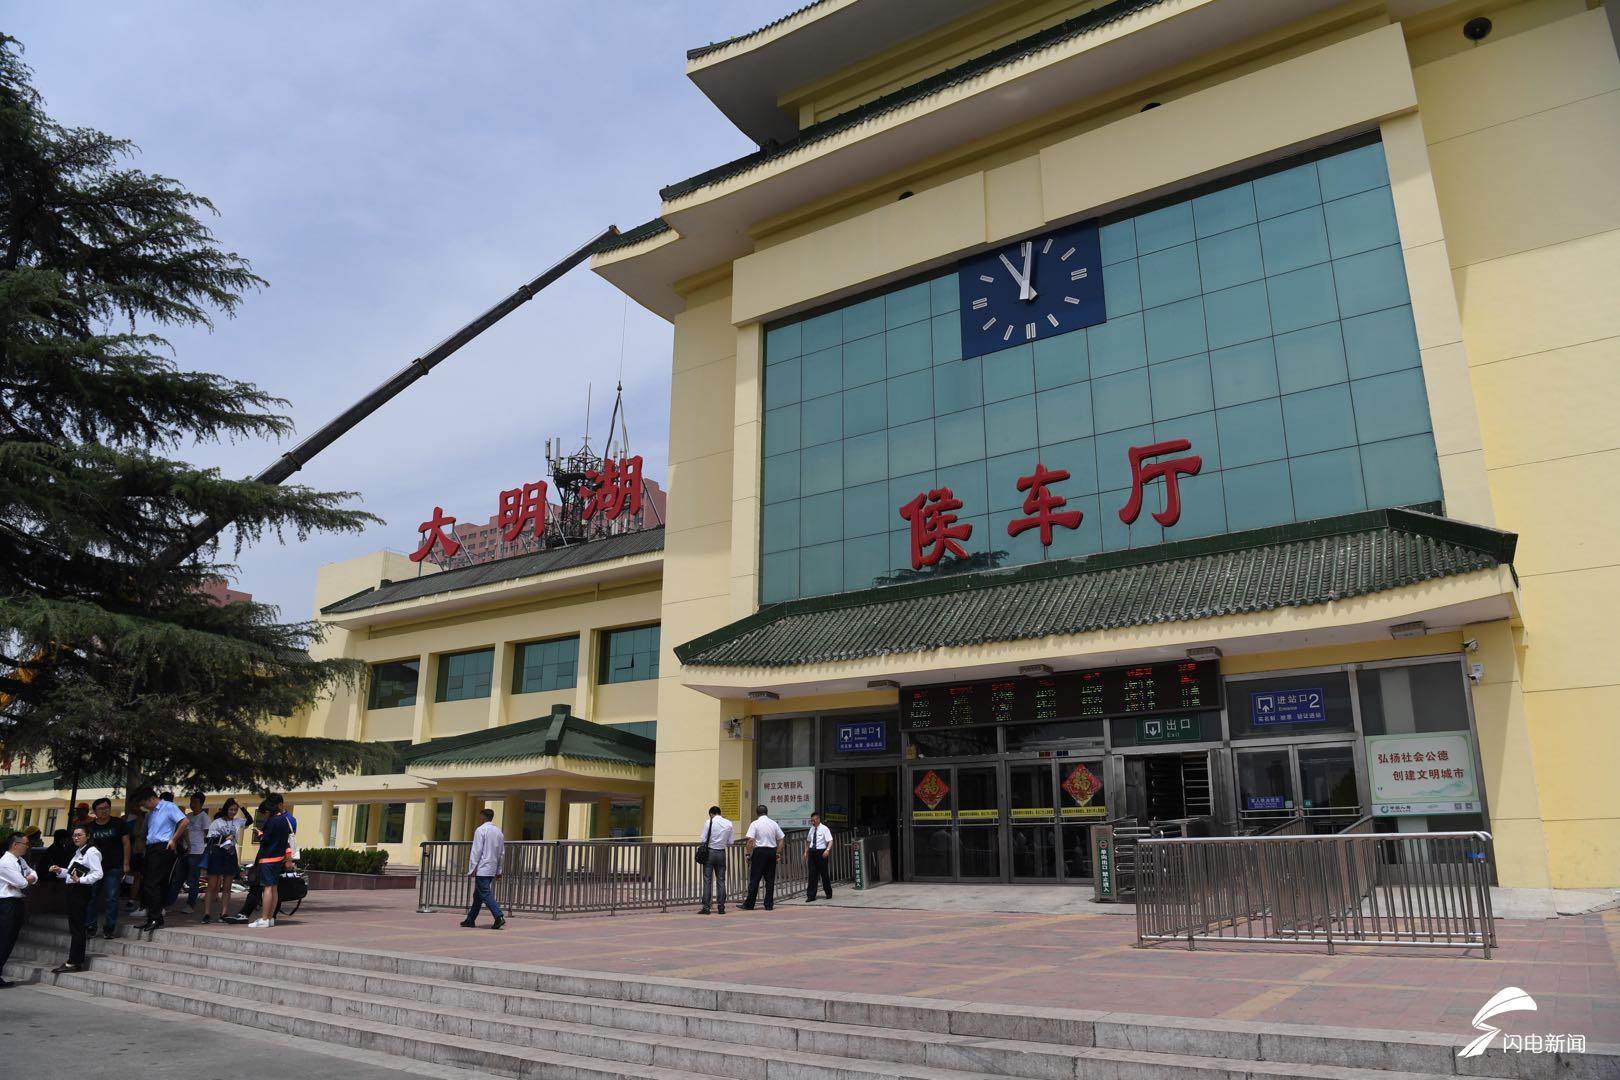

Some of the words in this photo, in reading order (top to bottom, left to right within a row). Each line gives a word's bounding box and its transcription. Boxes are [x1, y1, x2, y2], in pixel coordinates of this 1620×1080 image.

[409, 455, 644, 562] 大明湖
[899, 438, 1202, 570] 候车厅
[1166, 719, 1191, 731] 出口
[1377, 750, 1449, 764] 弘扬社会公德
[1392, 767, 1465, 781] 创建文明城市
[763, 781, 803, 790] 树立文明新风
[770, 793, 810, 803] 共创美好生活
